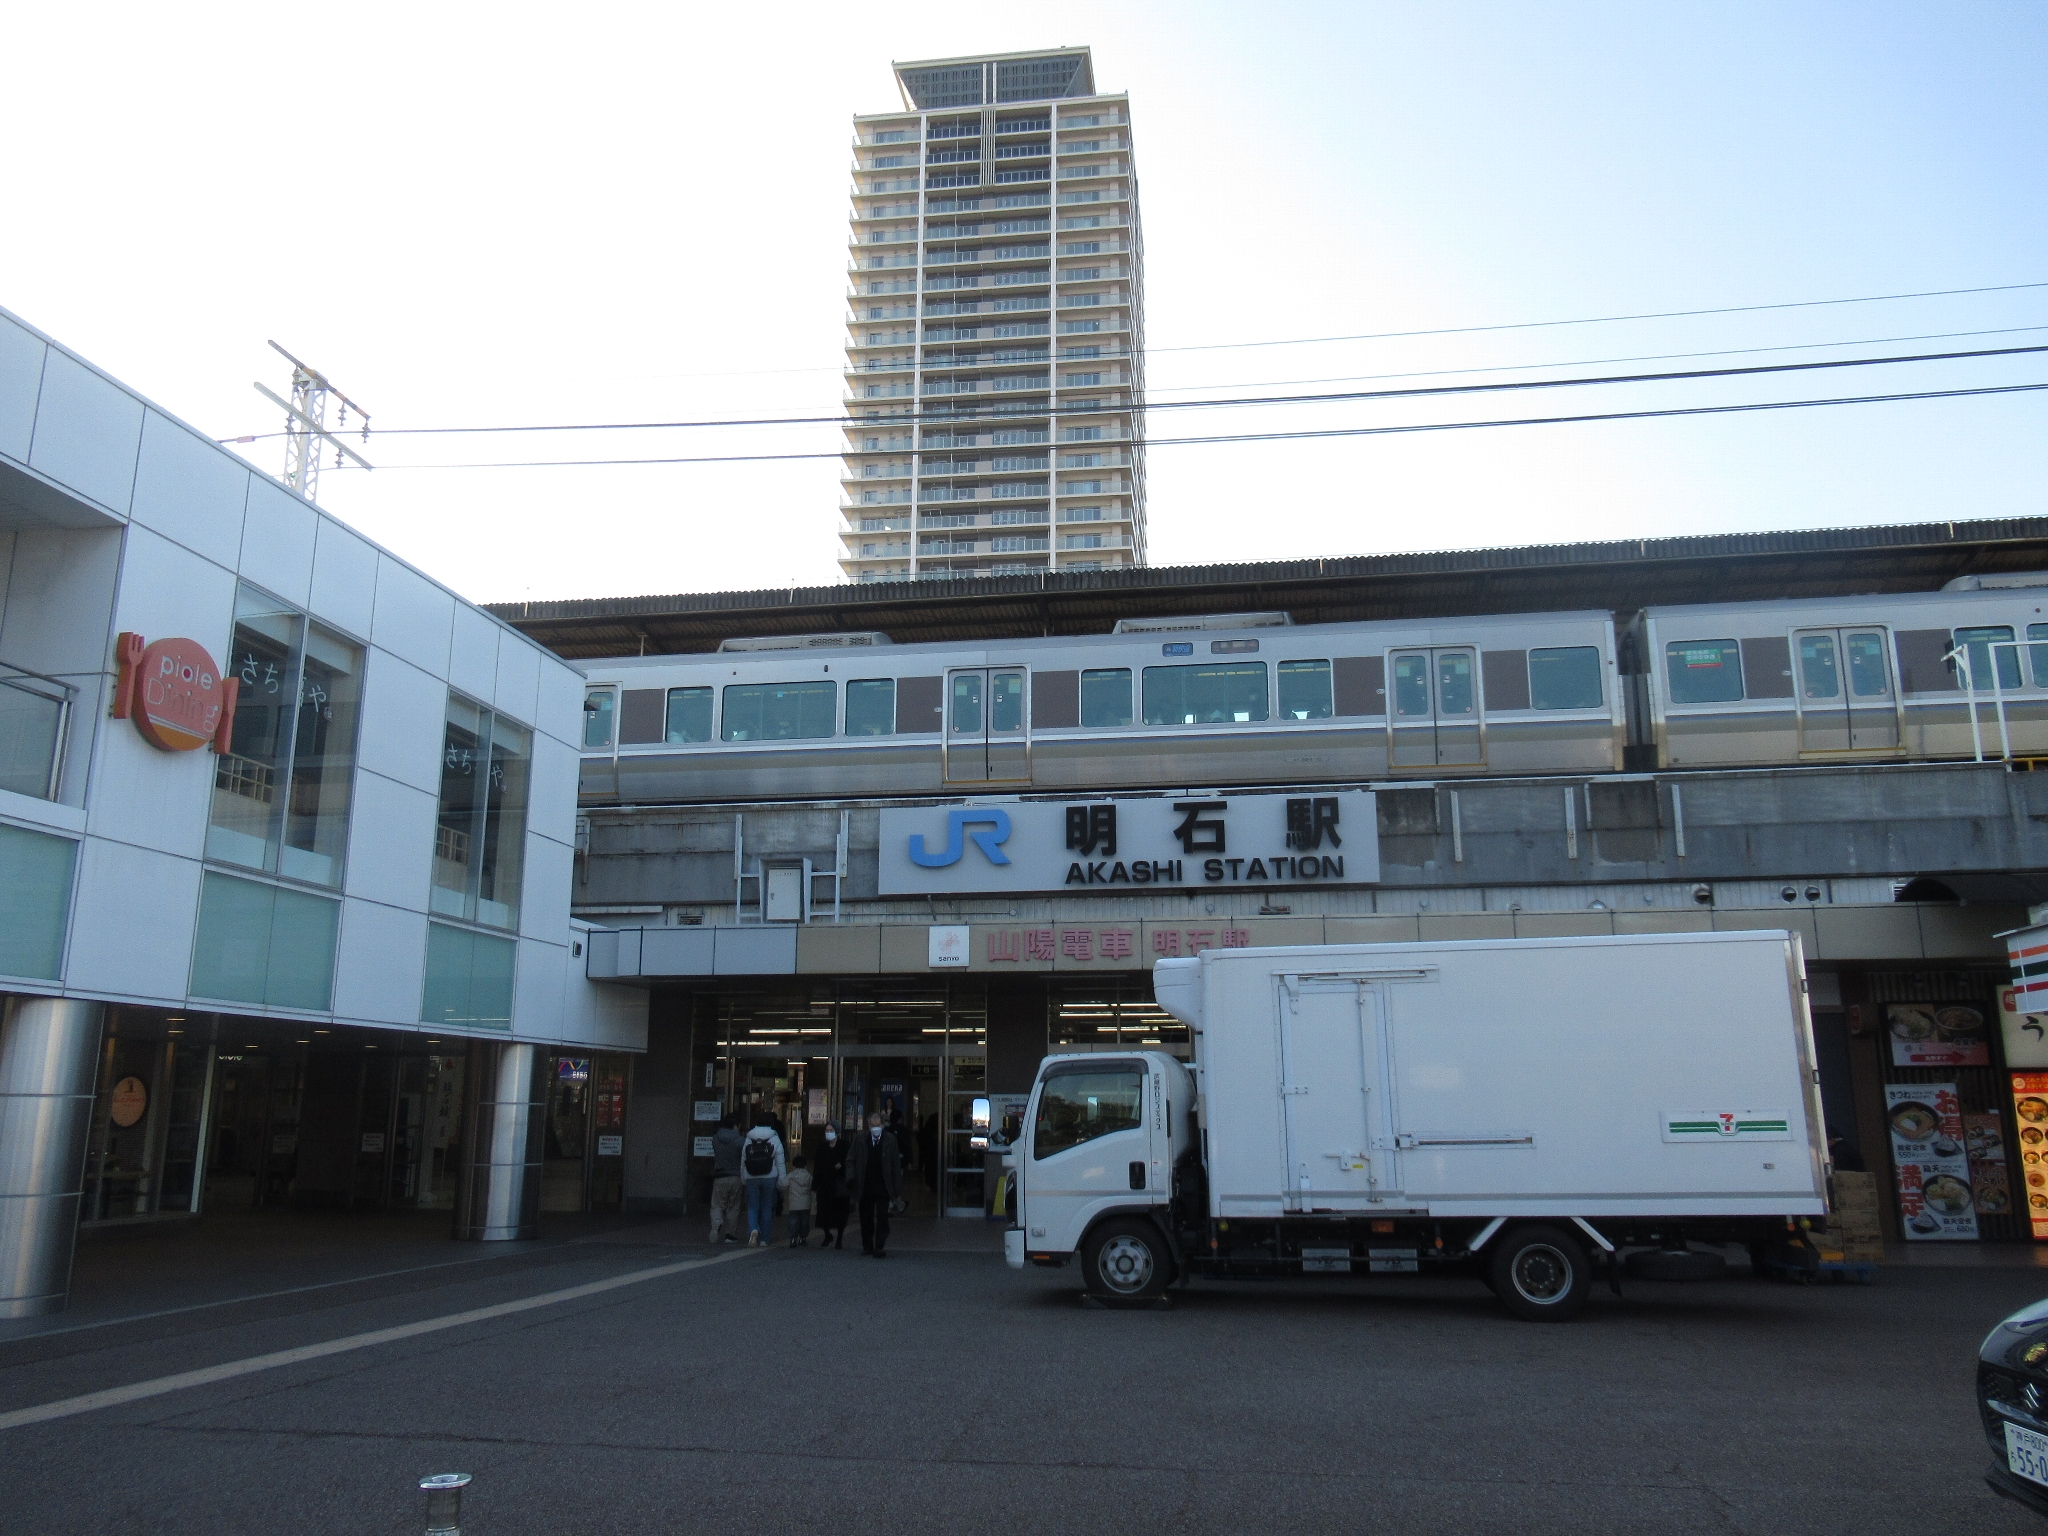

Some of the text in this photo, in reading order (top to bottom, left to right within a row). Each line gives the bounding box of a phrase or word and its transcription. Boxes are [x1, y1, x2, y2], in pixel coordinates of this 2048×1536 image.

[160, 654, 213, 691] piole
[147, 677, 219, 733] Dining
[909, 809, 1012, 867] JR
[1065, 797, 1342, 857] 明石駅
[1065, 855, 1344, 885] AKASHI STATION
[988, 927, 1249, 962] 山陽電車 明石駅
